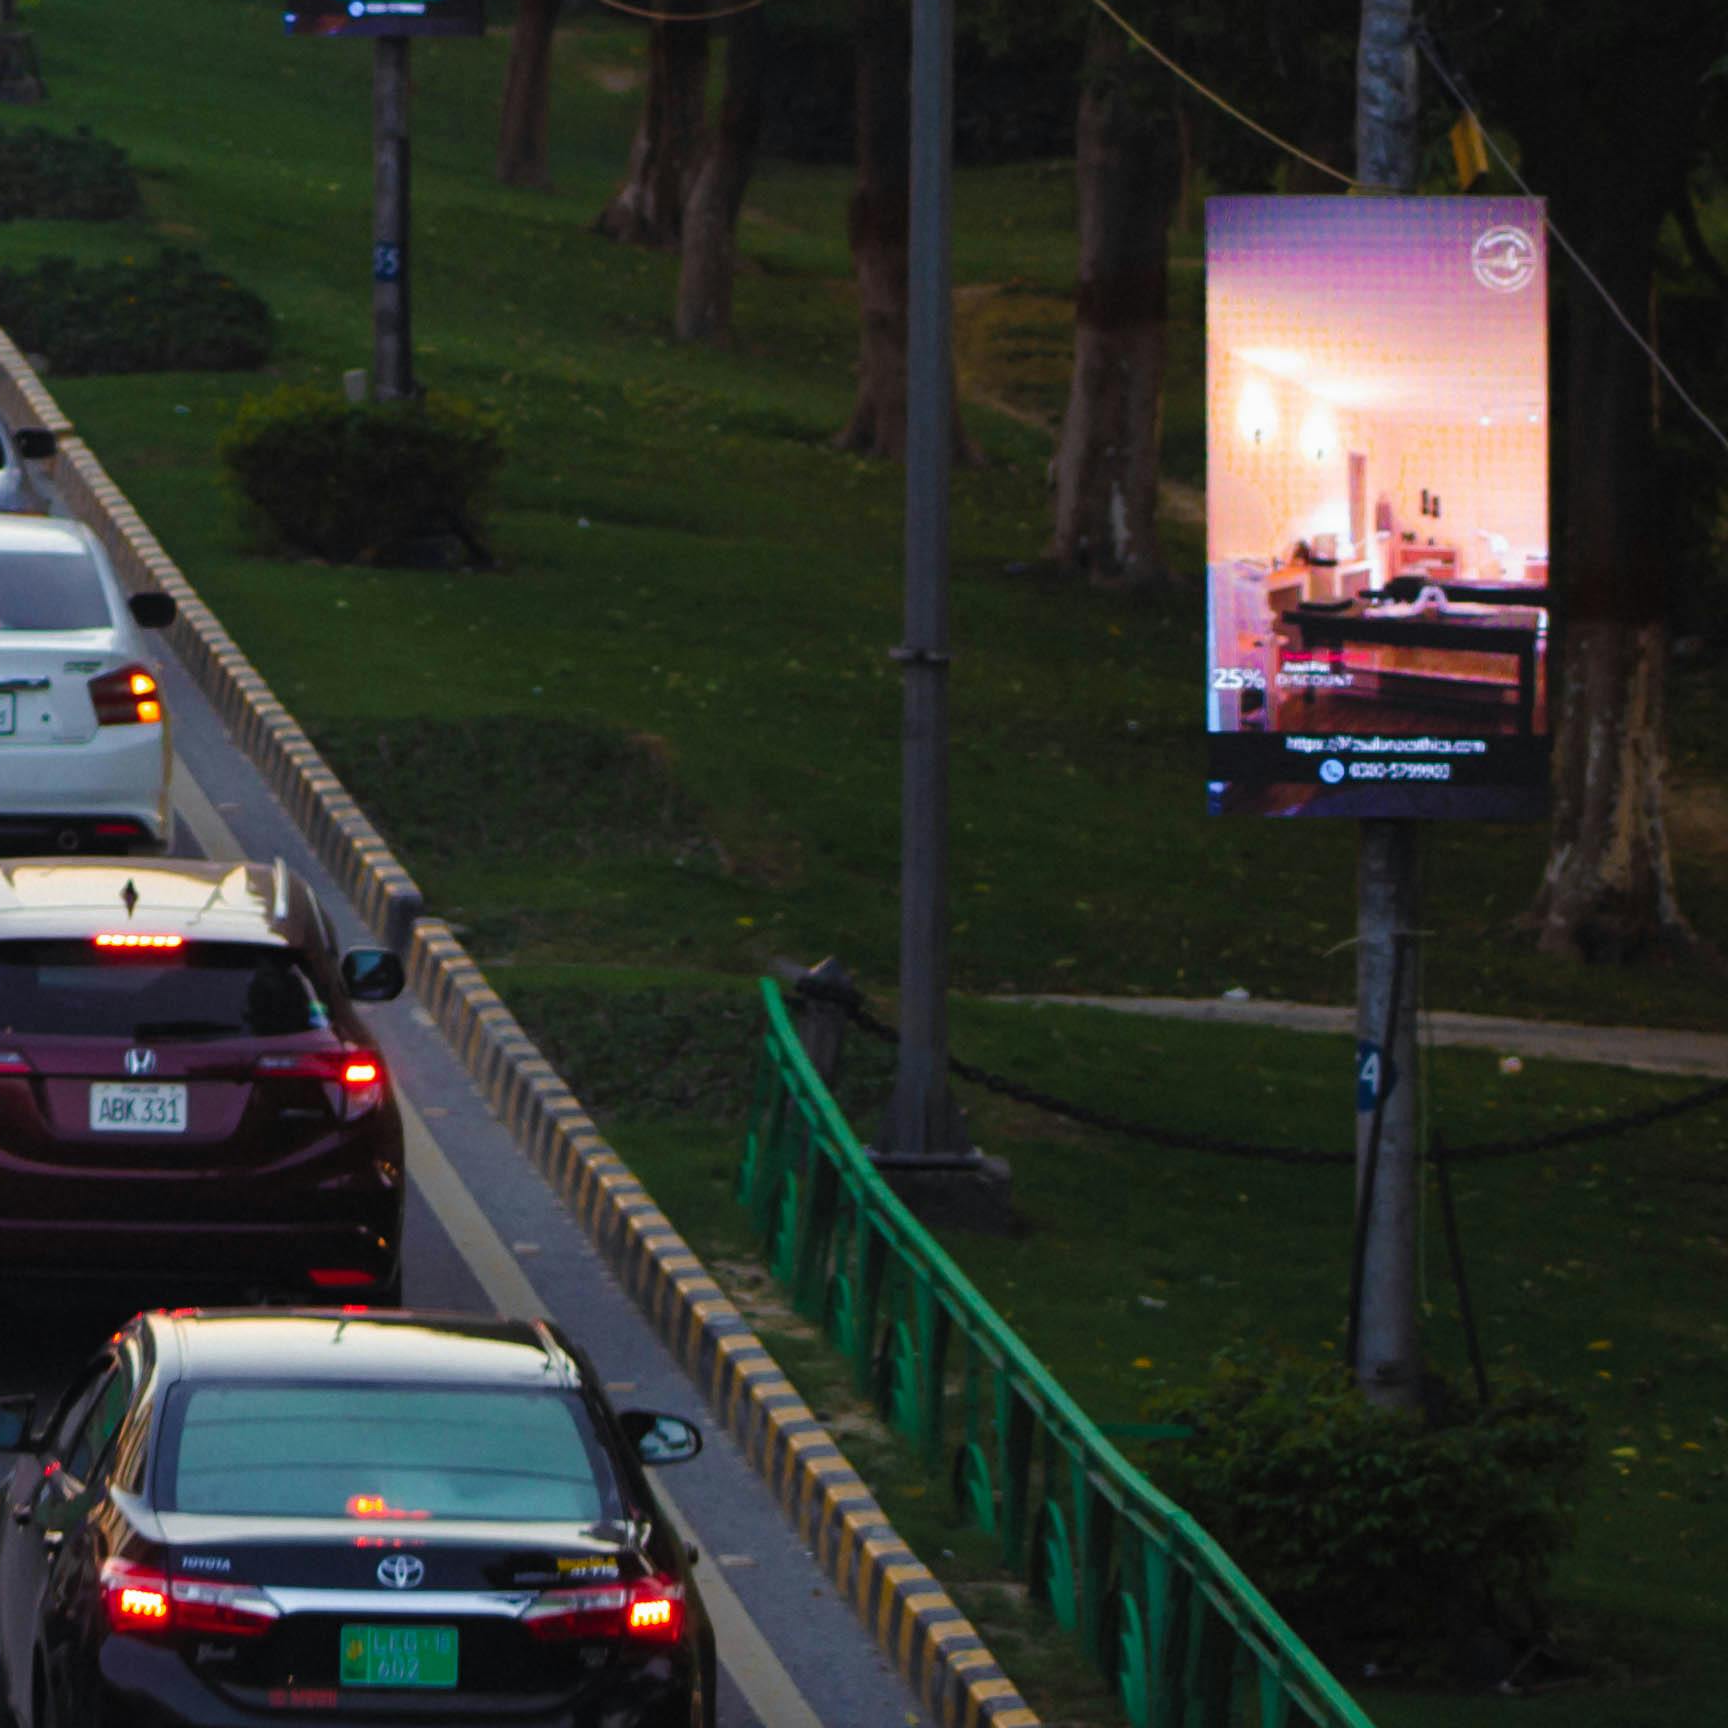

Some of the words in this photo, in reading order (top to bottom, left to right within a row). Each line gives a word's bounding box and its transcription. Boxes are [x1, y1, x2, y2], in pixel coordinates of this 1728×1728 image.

[1213, 668, 1266, 691] 25%
[98, 1097, 136, 1123] ABK
[141, 1097, 180, 1123] 331
[181, 1555, 232, 1571] TOYOTA
